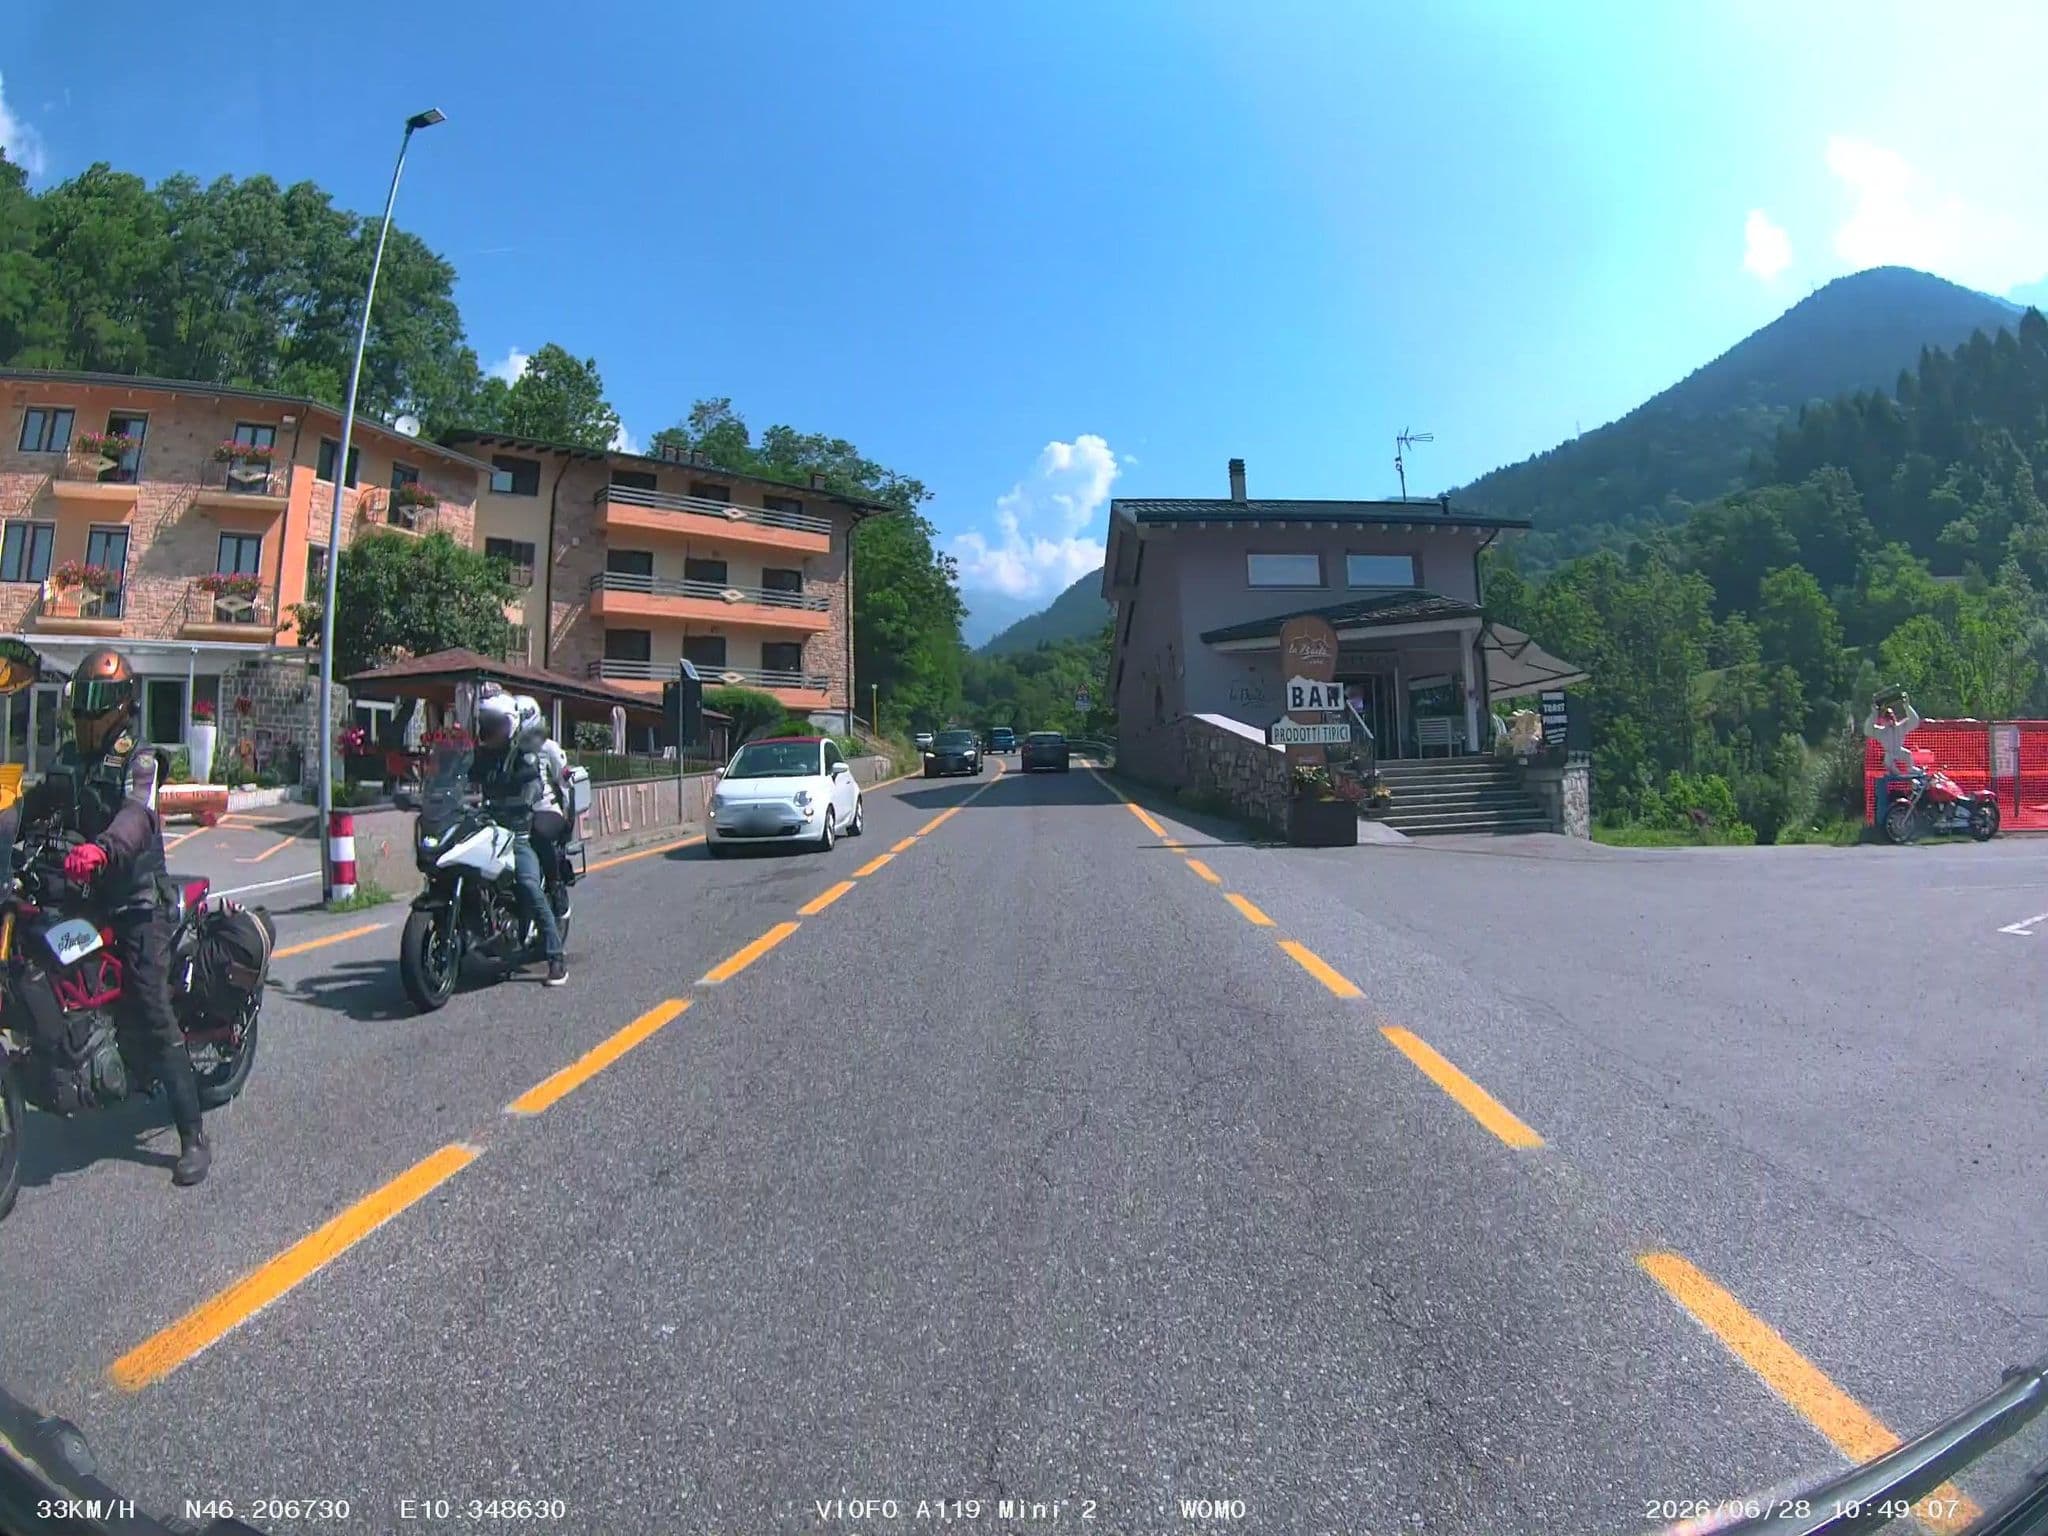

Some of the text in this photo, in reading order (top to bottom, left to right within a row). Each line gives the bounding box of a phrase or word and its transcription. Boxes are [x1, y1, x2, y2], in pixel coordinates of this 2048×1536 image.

[1291, 685, 1340, 707] BAR
[1274, 726, 1349, 742] PRODOTTI TIPICI
